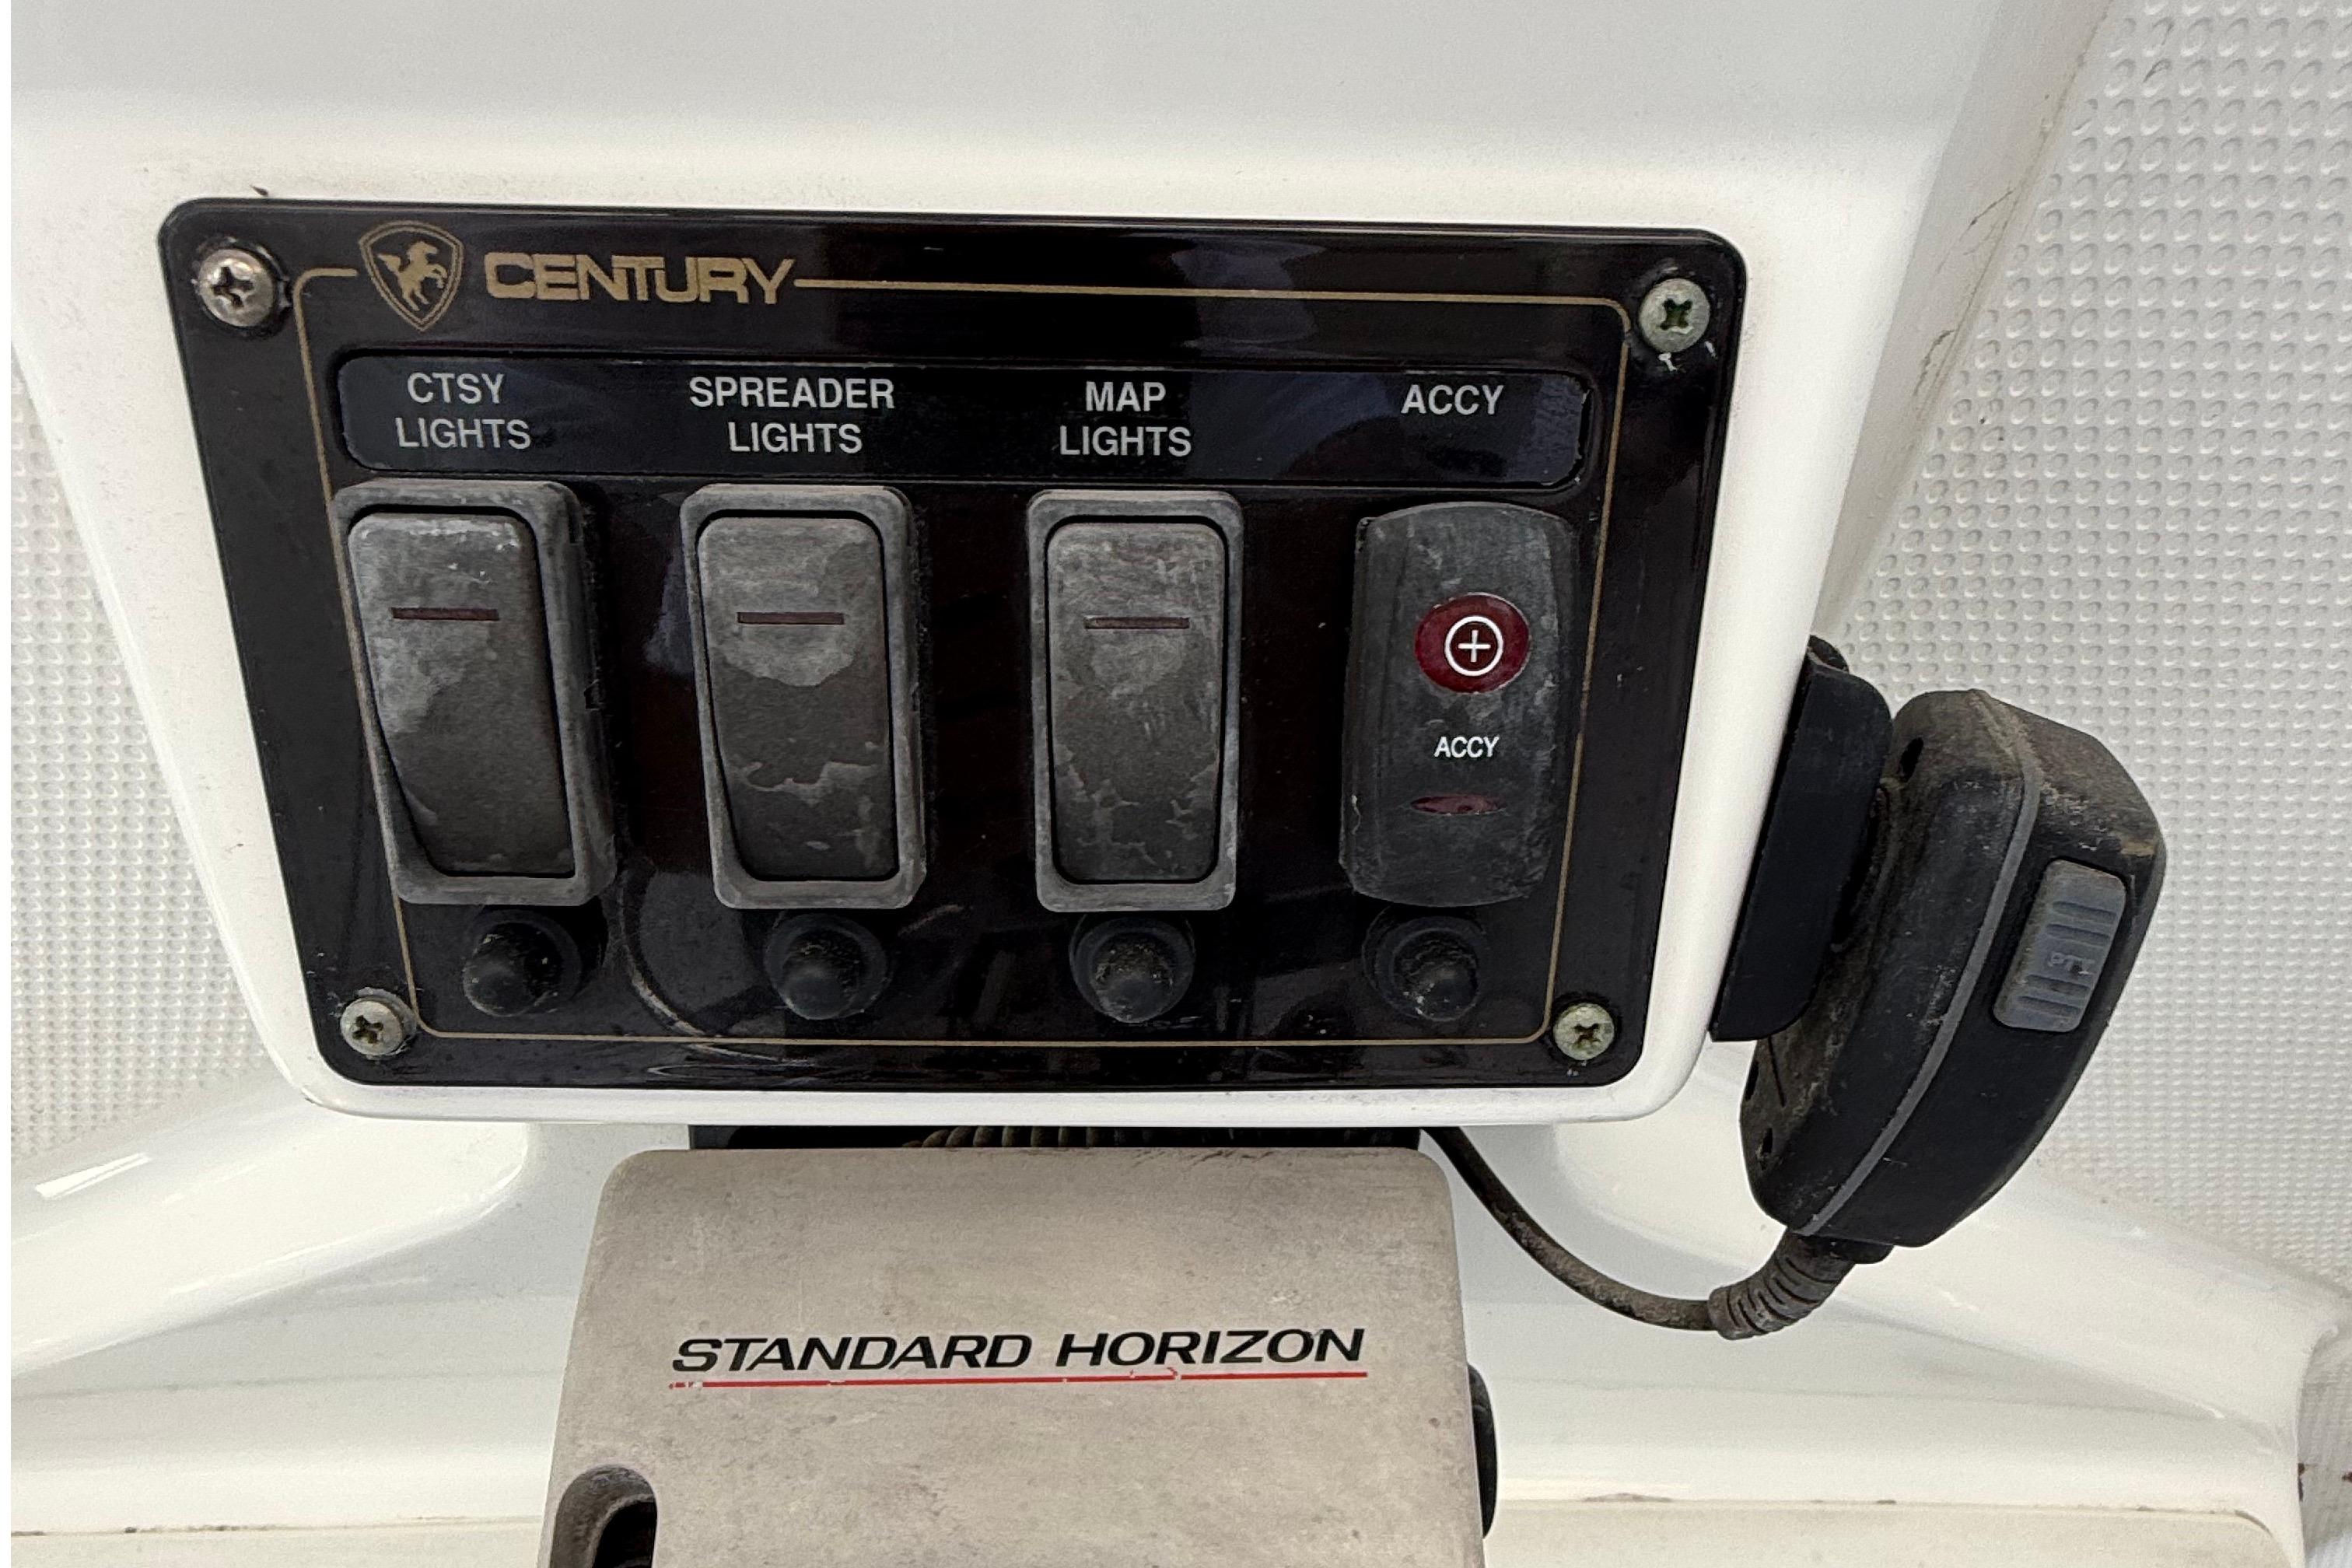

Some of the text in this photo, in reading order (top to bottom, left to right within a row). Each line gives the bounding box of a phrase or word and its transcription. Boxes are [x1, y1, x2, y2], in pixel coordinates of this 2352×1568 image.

[484, 250, 795, 305] CENTURY
[407, 372, 504, 404] CTSY
[689, 376, 895, 410] SPREADER
[1085, 380, 1167, 413] MAP
[1400, 384, 1504, 415] ACCY
[395, 417, 532, 450] LIGHTS
[728, 422, 863, 455] LIGHTS
[1059, 425, 1192, 457] LIGHTS
[1433, 735, 1500, 759] ACCY
[672, 1328, 1366, 1372] STANDARD HORIZON
